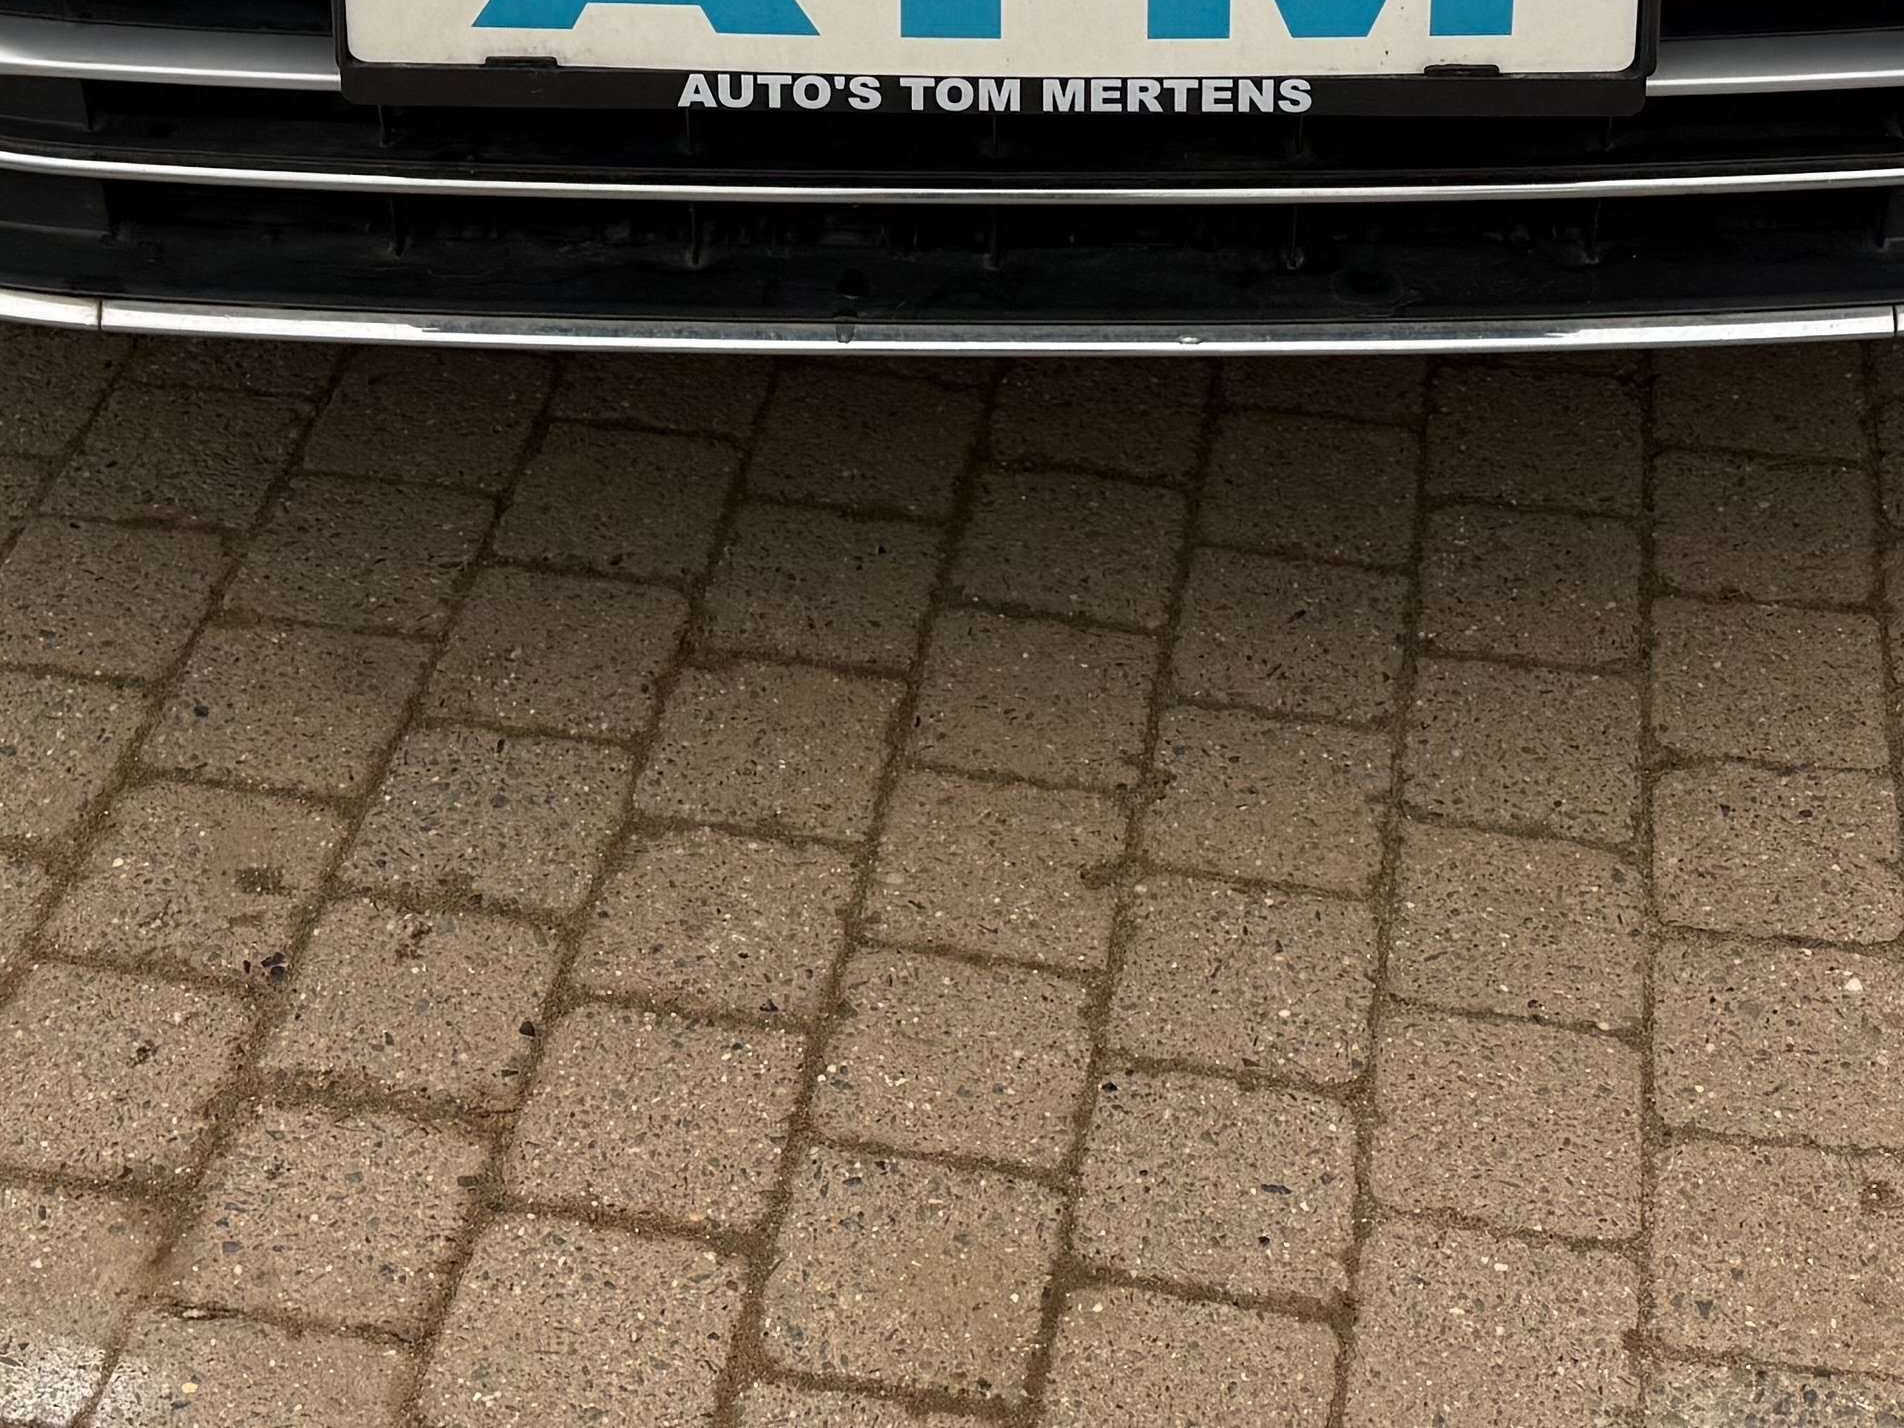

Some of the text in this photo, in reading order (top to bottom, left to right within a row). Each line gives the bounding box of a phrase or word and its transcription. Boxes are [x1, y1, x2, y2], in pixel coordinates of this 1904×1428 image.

[677, 73, 1312, 113] AUTO'S TOM MERTENS
